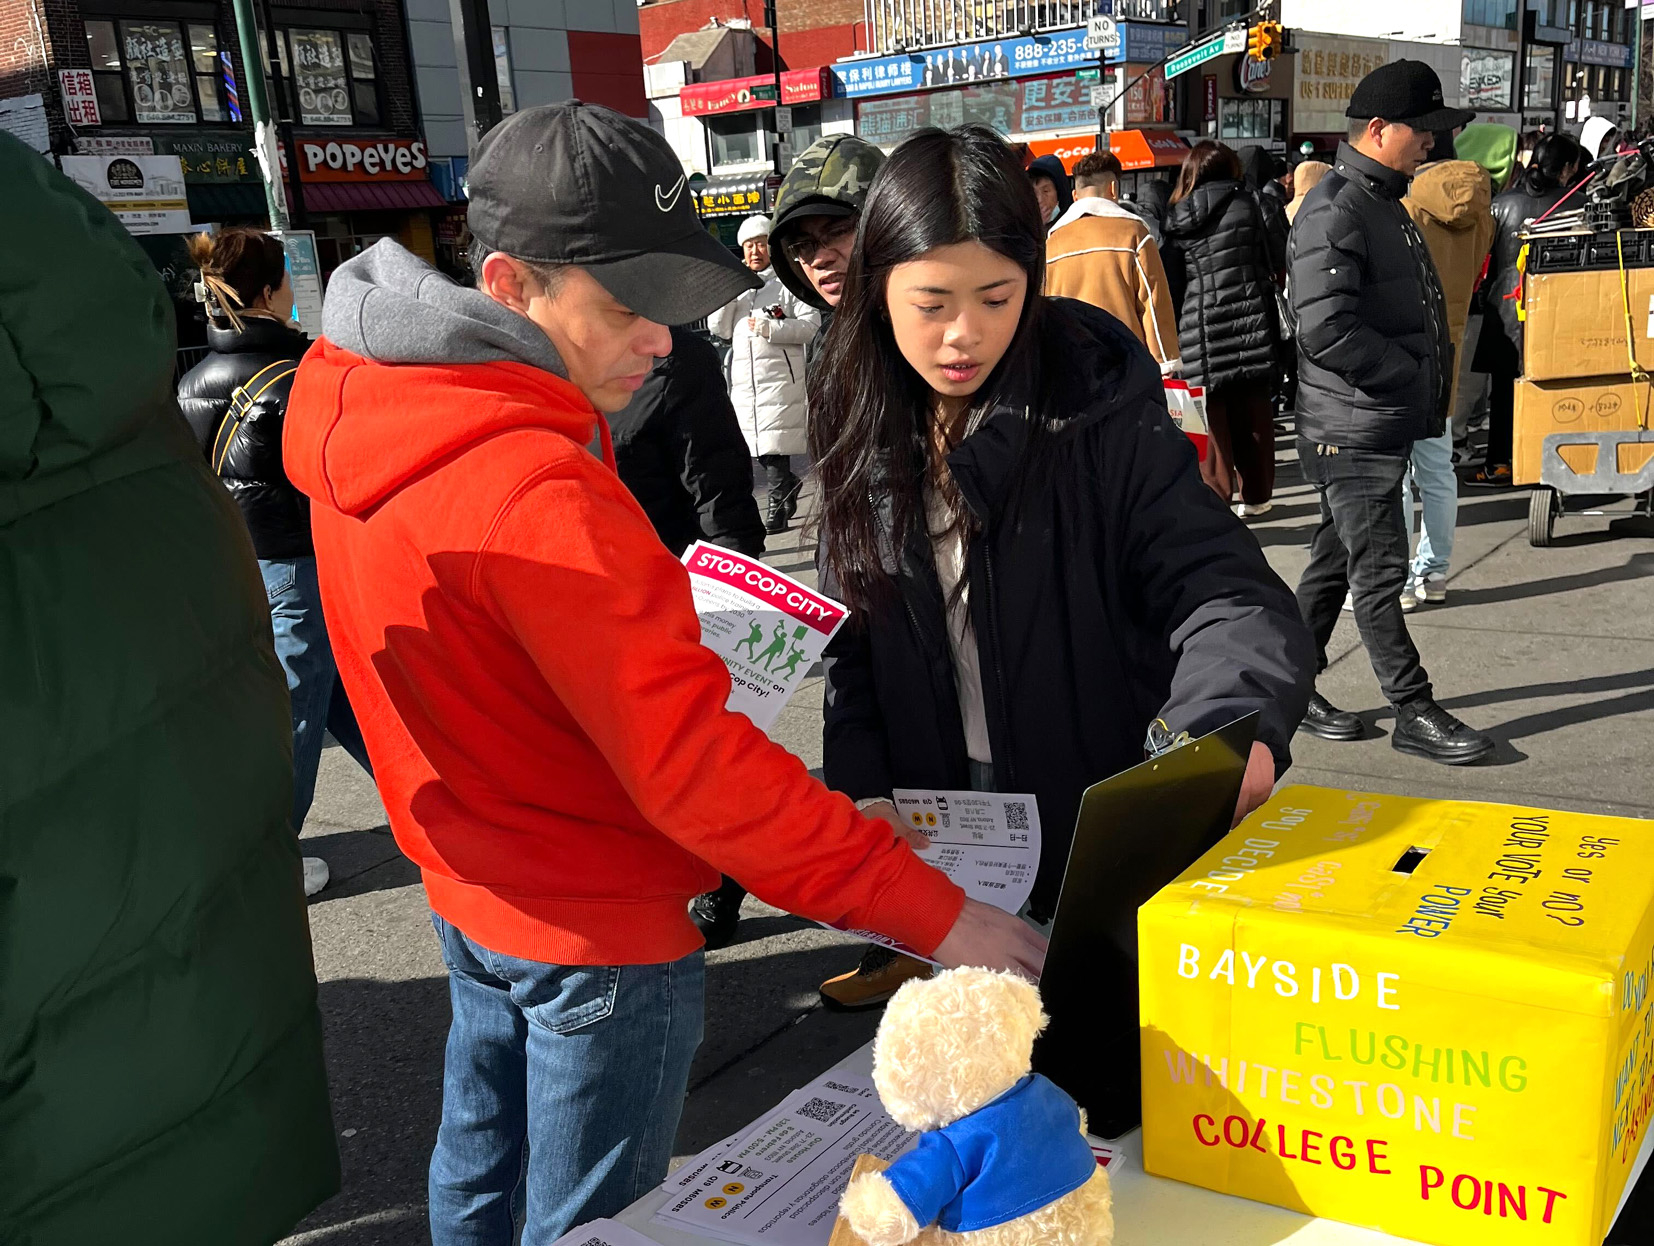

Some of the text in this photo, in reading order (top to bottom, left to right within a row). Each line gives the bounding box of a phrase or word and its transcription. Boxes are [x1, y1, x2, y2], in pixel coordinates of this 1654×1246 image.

[1089, 34, 1115, 45] TURNS
[1094, 20, 1109, 32] NO
[1170, 48, 1208, 73] Roosevelt
[1208, 44, 1220, 54] Av
[61, 71, 93, 96] 信箱
[68, 100, 100, 124] 出租
[207, 143, 243, 153] BAKERY
[697, 553, 833, 621] STOP COP CITY
[732, 590, 740, 598] to
[740, 594, 756, 608] build
[729, 608, 745, 618] 2030
[730, 600, 754, 615] training
[712, 622, 732, 635] public
[714, 616, 736, 629] money
[730, 672, 770, 698] Cop City!
[744, 668, 773, 686] EVENT
[773, 683, 785, 694] on
[1191, 837, 1280, 894] DECIDE
[1472, 815, 1550, 920] YOUR VOTE your
[1562, 868, 1593, 884] or
[1395, 884, 1473, 939] POWER
[1177, 943, 1401, 1010] BAYSIDE
[1623, 970, 1635, 1011] DO
[1294, 1021, 1528, 1093] FLUSHING
[1615, 1030, 1641, 1111] WANT
[1164, 1049, 1478, 1141] WHITESTONE
[1612, 1080, 1637, 1158] NEXT
[756, 1137, 781, 1156] Febrero
[843, 1120, 881, 1150] Comida gratis
[787, 1147, 810, 1163] House
[1193, 1113, 1568, 1225] COLLEGE POINT
[672, 1176, 718, 1212] Q19 M60SBS
[721, 1175, 778, 1219] Transporte Público
[789, 1185, 830, 1219] discapacidad
[794, 1175, 829, 1202] obligatorias
[758, 1207, 791, 1233] repartidos
